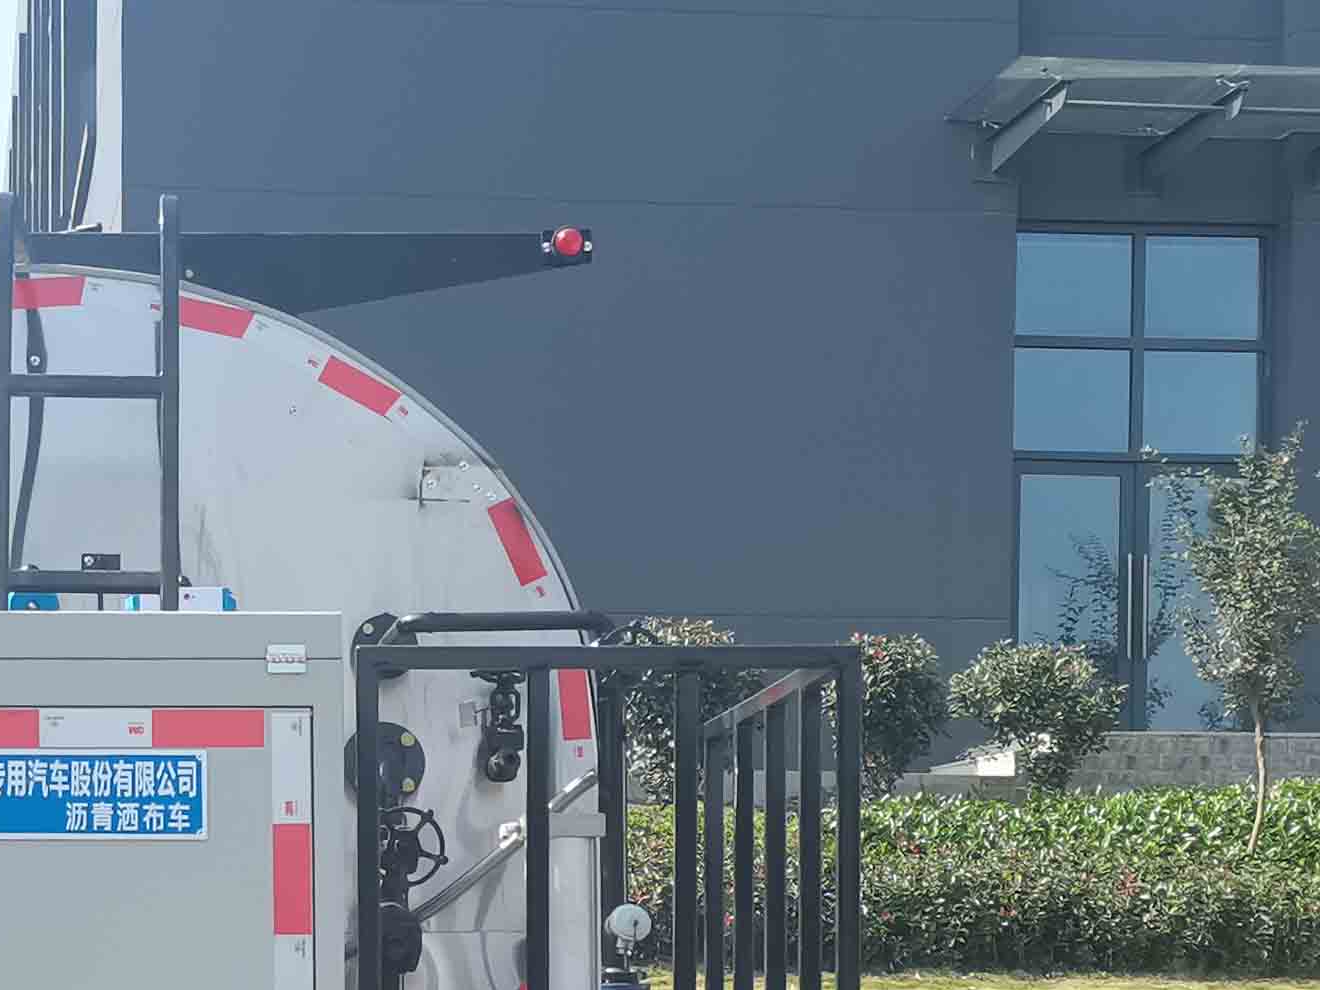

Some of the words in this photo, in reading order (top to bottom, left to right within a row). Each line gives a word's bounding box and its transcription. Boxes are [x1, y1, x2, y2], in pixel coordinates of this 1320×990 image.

[65, 802, 191, 832] 沥青洒布车
